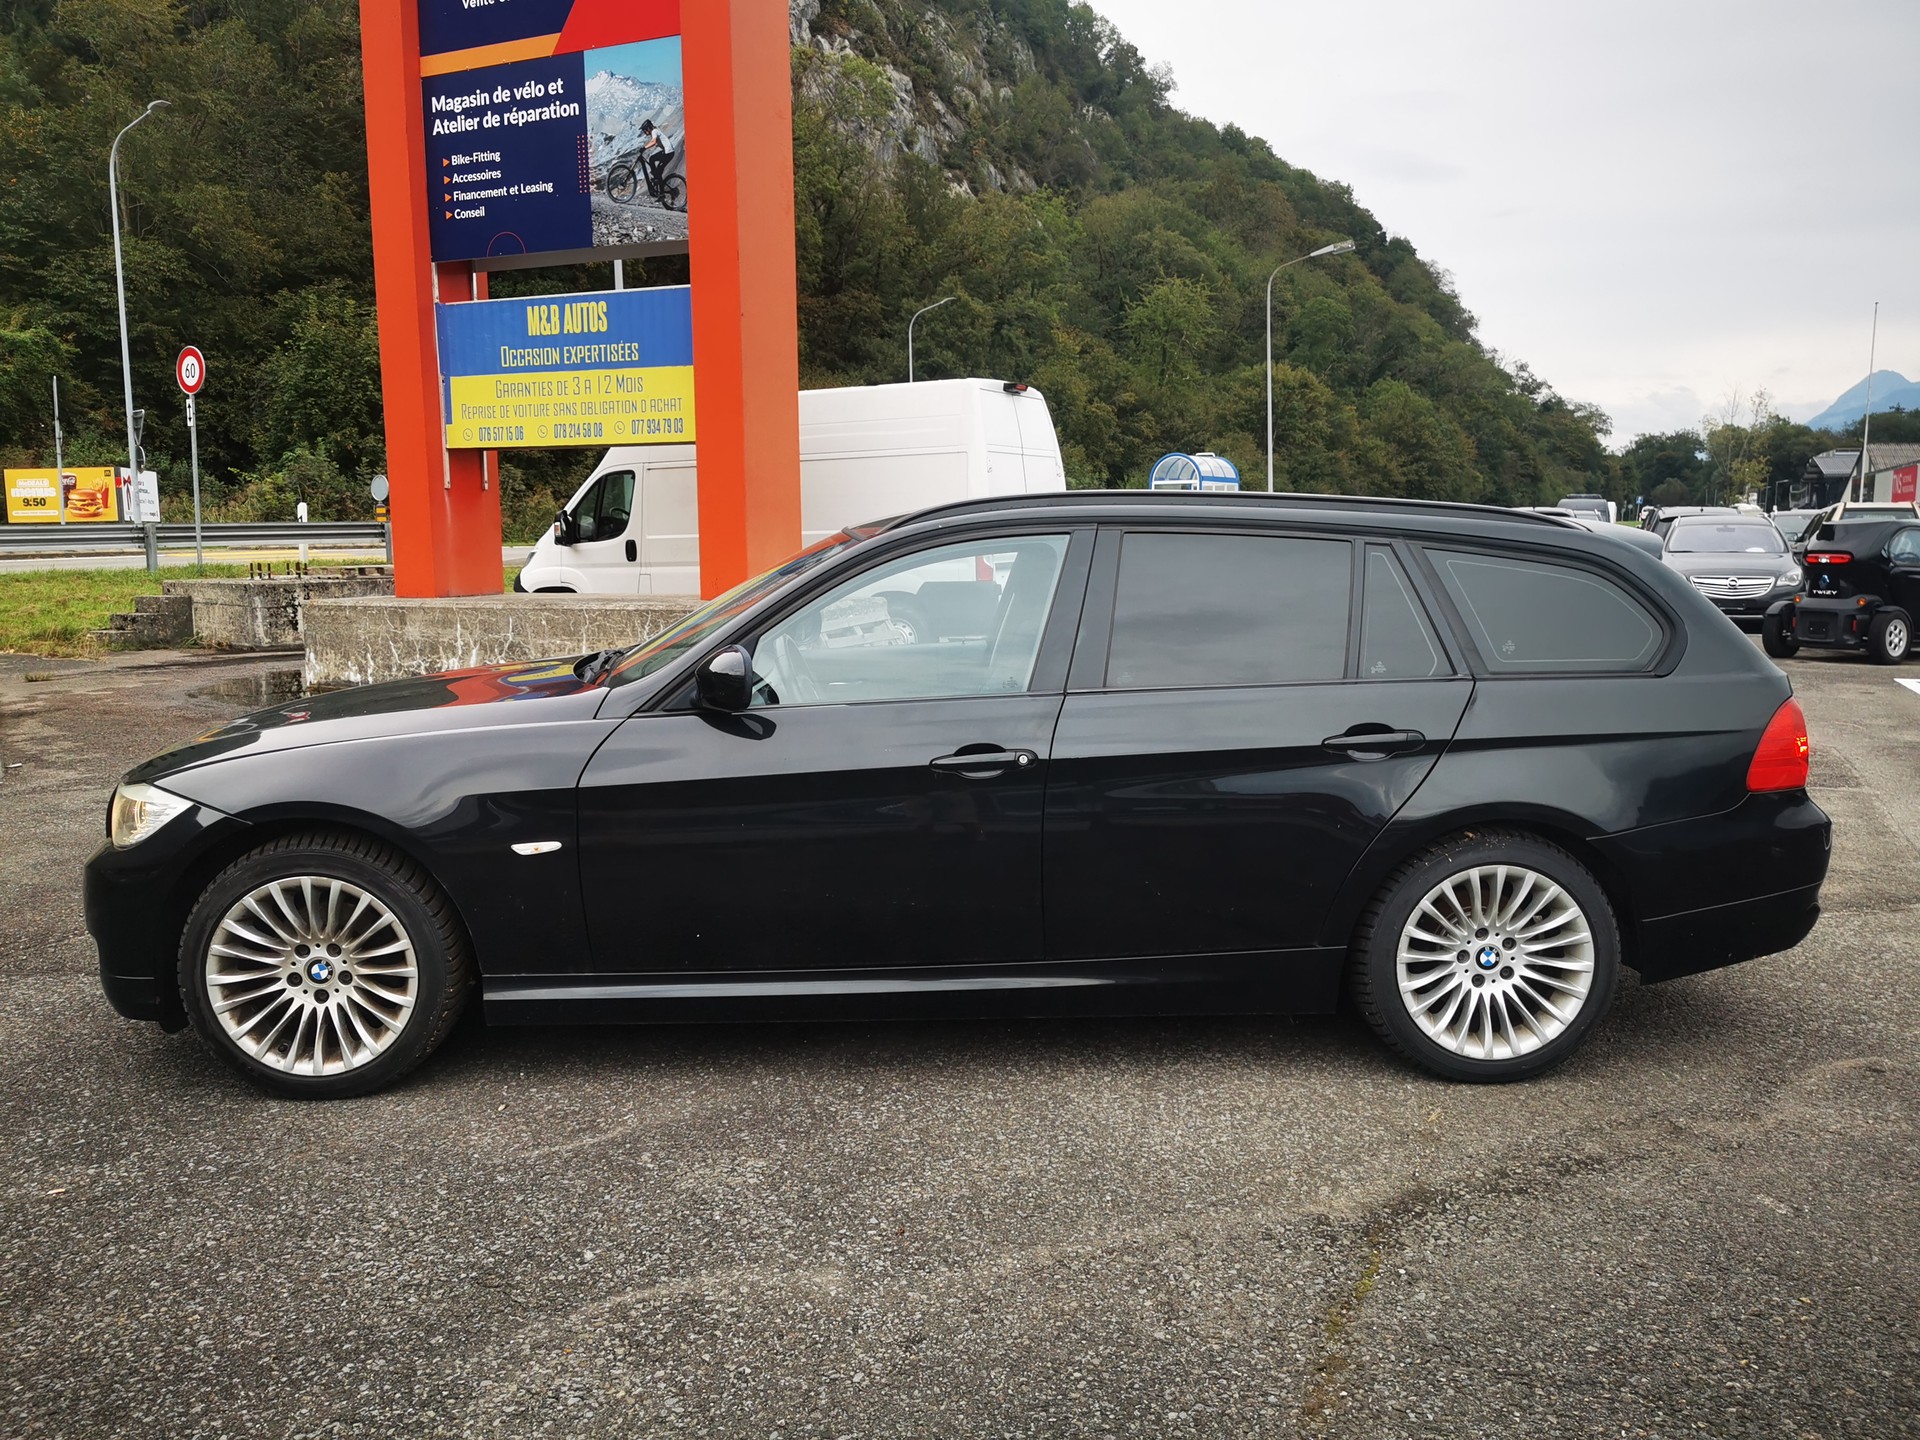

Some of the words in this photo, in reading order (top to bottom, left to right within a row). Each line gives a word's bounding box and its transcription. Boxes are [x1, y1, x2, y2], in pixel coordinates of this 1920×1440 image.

[431, 89, 490, 113] Magasin
[493, 86, 511, 103] de
[513, 80, 545, 100] vélo
[547, 78, 564, 95] et
[432, 115, 480, 135] Atelier
[482, 111, 501, 128] de
[503, 101, 580, 126] réparation
[451, 150, 501, 166] Bike-Fitting
[452, 169, 502, 184] Accessoires
[453, 186, 508, 201] Financement
[509, 185, 519, 195] et
[520, 181, 554, 194] Leasing
[454, 206, 485, 219] Conseil
[526, 304, 560, 336] M&B
[563, 301, 608, 334] AUTOS
[500, 346, 560, 367] OCCASION
[563, 340, 639, 364] EXPERTISÉES
[185, 363, 196, 378] 60
[495, 379, 553, 398] GARANTIES
[556, 380, 569, 396] DE
[572, 376, 580, 395] 3
[616, 374, 643, 393] MOIS
[461, 403, 497, 420] REPRISE
[499, 405, 510, 418] DE
[513, 403, 550, 418] VOITURE
[553, 402, 577, 417] SANS
[580, 400, 638, 415] OBLIGATION
[478, 426, 491, 442] 076
[493, 426, 504, 442] 517
[506, 425, 513, 441] 15
[554, 423, 567, 439] 078
[568, 423, 581, 438] 214
[583, 422, 591, 437] 58
[631, 419, 644, 434] 077
[647, 418, 660, 434] 934
[662, 418, 672, 433] 79
[674, 417, 684, 433] 03
